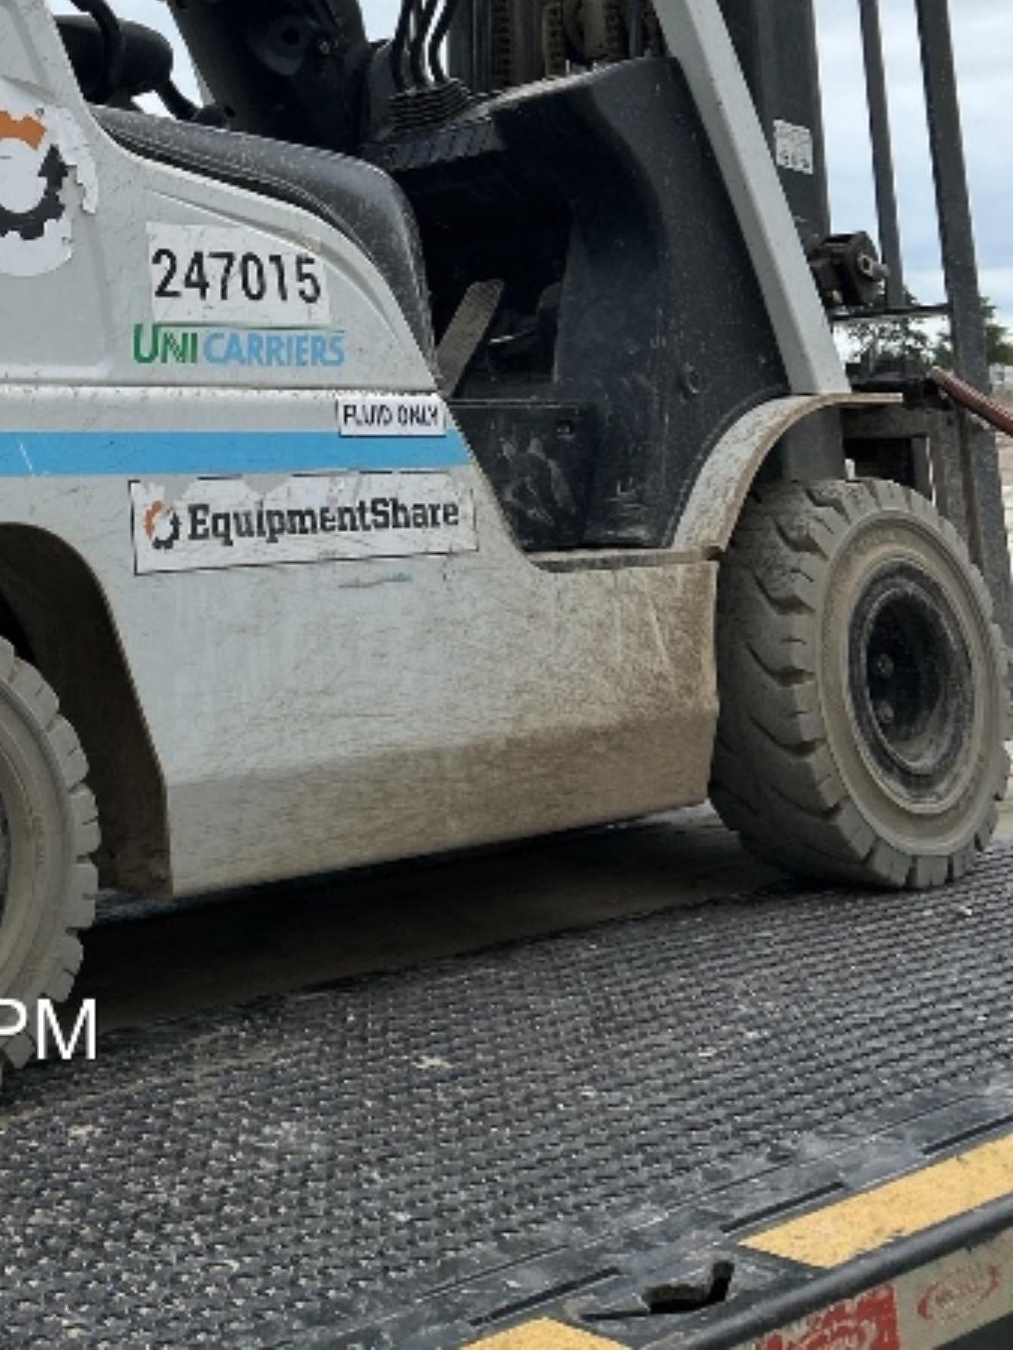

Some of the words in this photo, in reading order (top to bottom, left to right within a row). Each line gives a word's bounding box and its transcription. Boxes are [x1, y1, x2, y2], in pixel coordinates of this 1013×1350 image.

[151, 247, 322, 303] 247015
[343, 403, 393, 426] FLUID
[397, 403, 438, 426] ONLY
[188, 497, 460, 546] EquipmentShare
